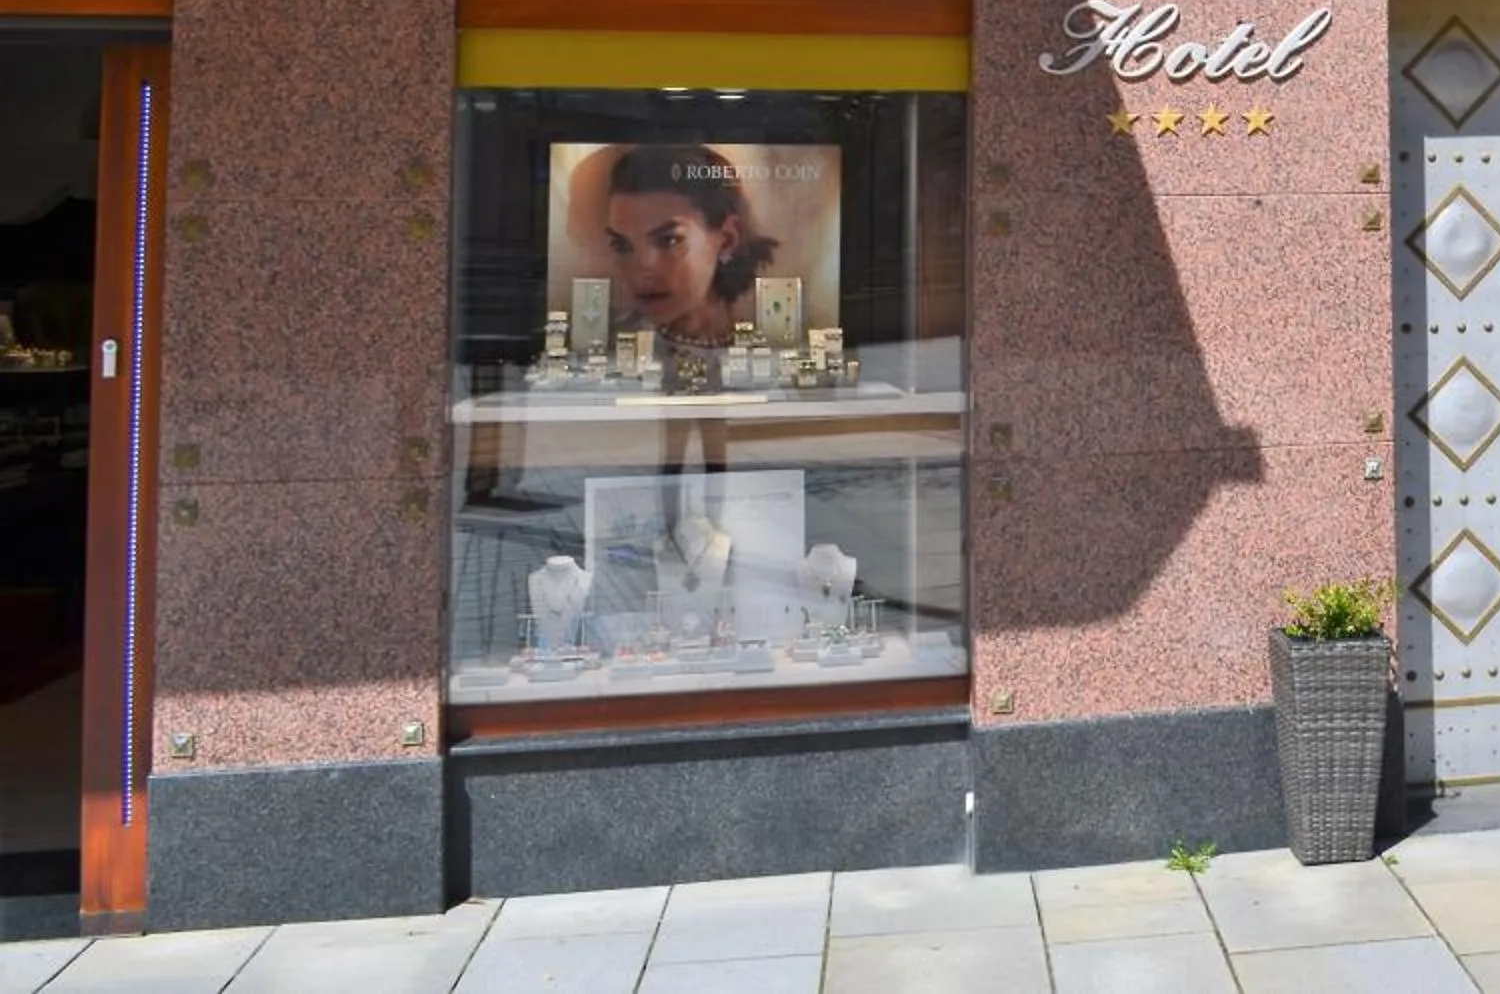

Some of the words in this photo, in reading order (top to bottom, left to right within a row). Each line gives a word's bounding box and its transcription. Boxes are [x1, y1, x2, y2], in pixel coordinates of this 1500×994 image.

[1039, 0, 1331, 79] Hotel
[686, 165, 770, 180] ROBERTO
[775, 164, 822, 180] COIN
